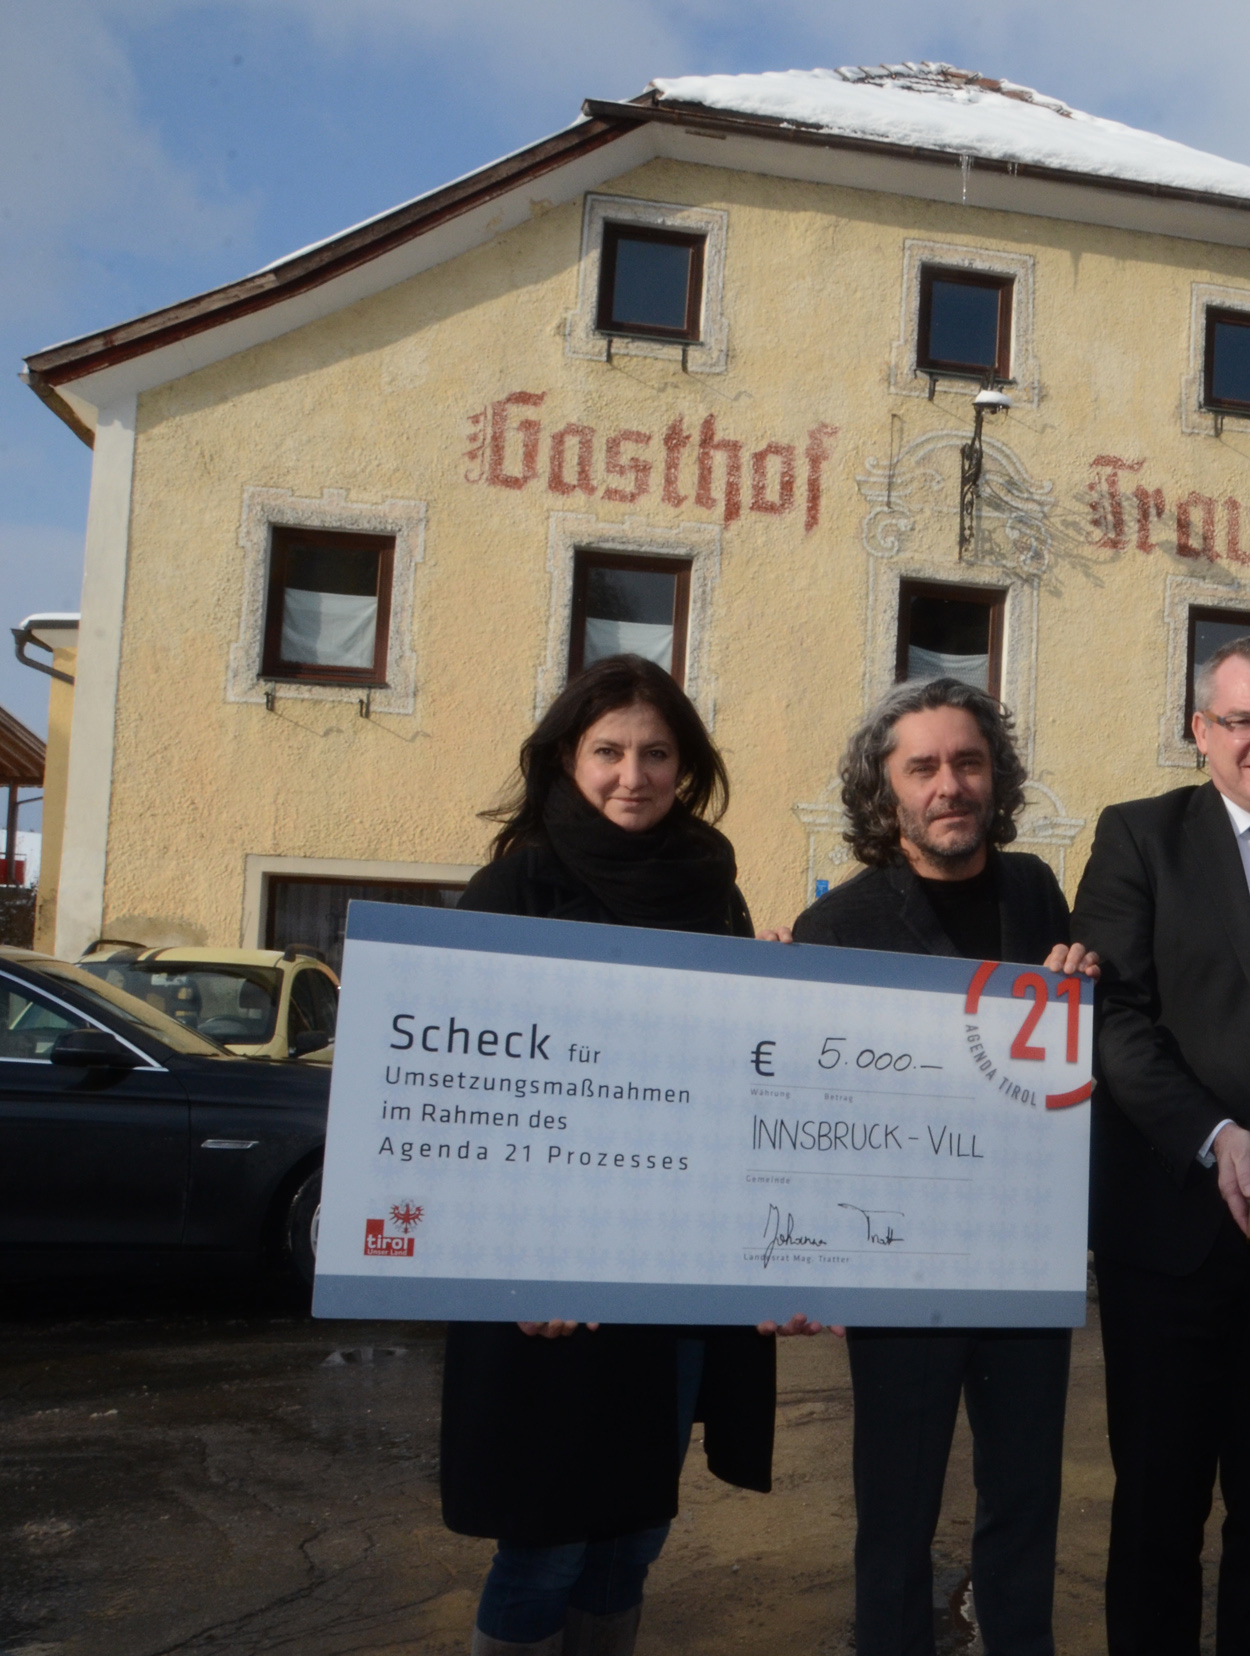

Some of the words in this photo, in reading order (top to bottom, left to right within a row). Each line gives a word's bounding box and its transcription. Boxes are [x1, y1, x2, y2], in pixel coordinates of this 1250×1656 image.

[463, 391, 840, 533] Gasthof
[1010, 972, 1081, 1063] 21
[390, 1014, 551, 1060] Scheck
[568, 1043, 602, 1064] für
[751, 1040, 776, 1077] €
[965, 1023, 998, 1081] AGENDA
[998, 1076, 1037, 1107] TIROL
[385, 1065, 690, 1103] Umsetzungsmaßnahmen
[751, 1088, 791, 1099] Währung
[824, 1093, 853, 1103] Betrag
[382, 1101, 411, 1121] im
[422, 1104, 519, 1127] Rahmen
[529, 1110, 568, 1130] des
[379, 1136, 489, 1161] Agenda
[505, 1143, 531, 1162] 21
[548, 1146, 689, 1170] Prozesses
[746, 1175, 791, 1185] Gemeinde
[367, 1234, 409, 1250] tirol
[793, 1254, 814, 1264] Mag.
[818, 1255, 850, 1264] Tratter
